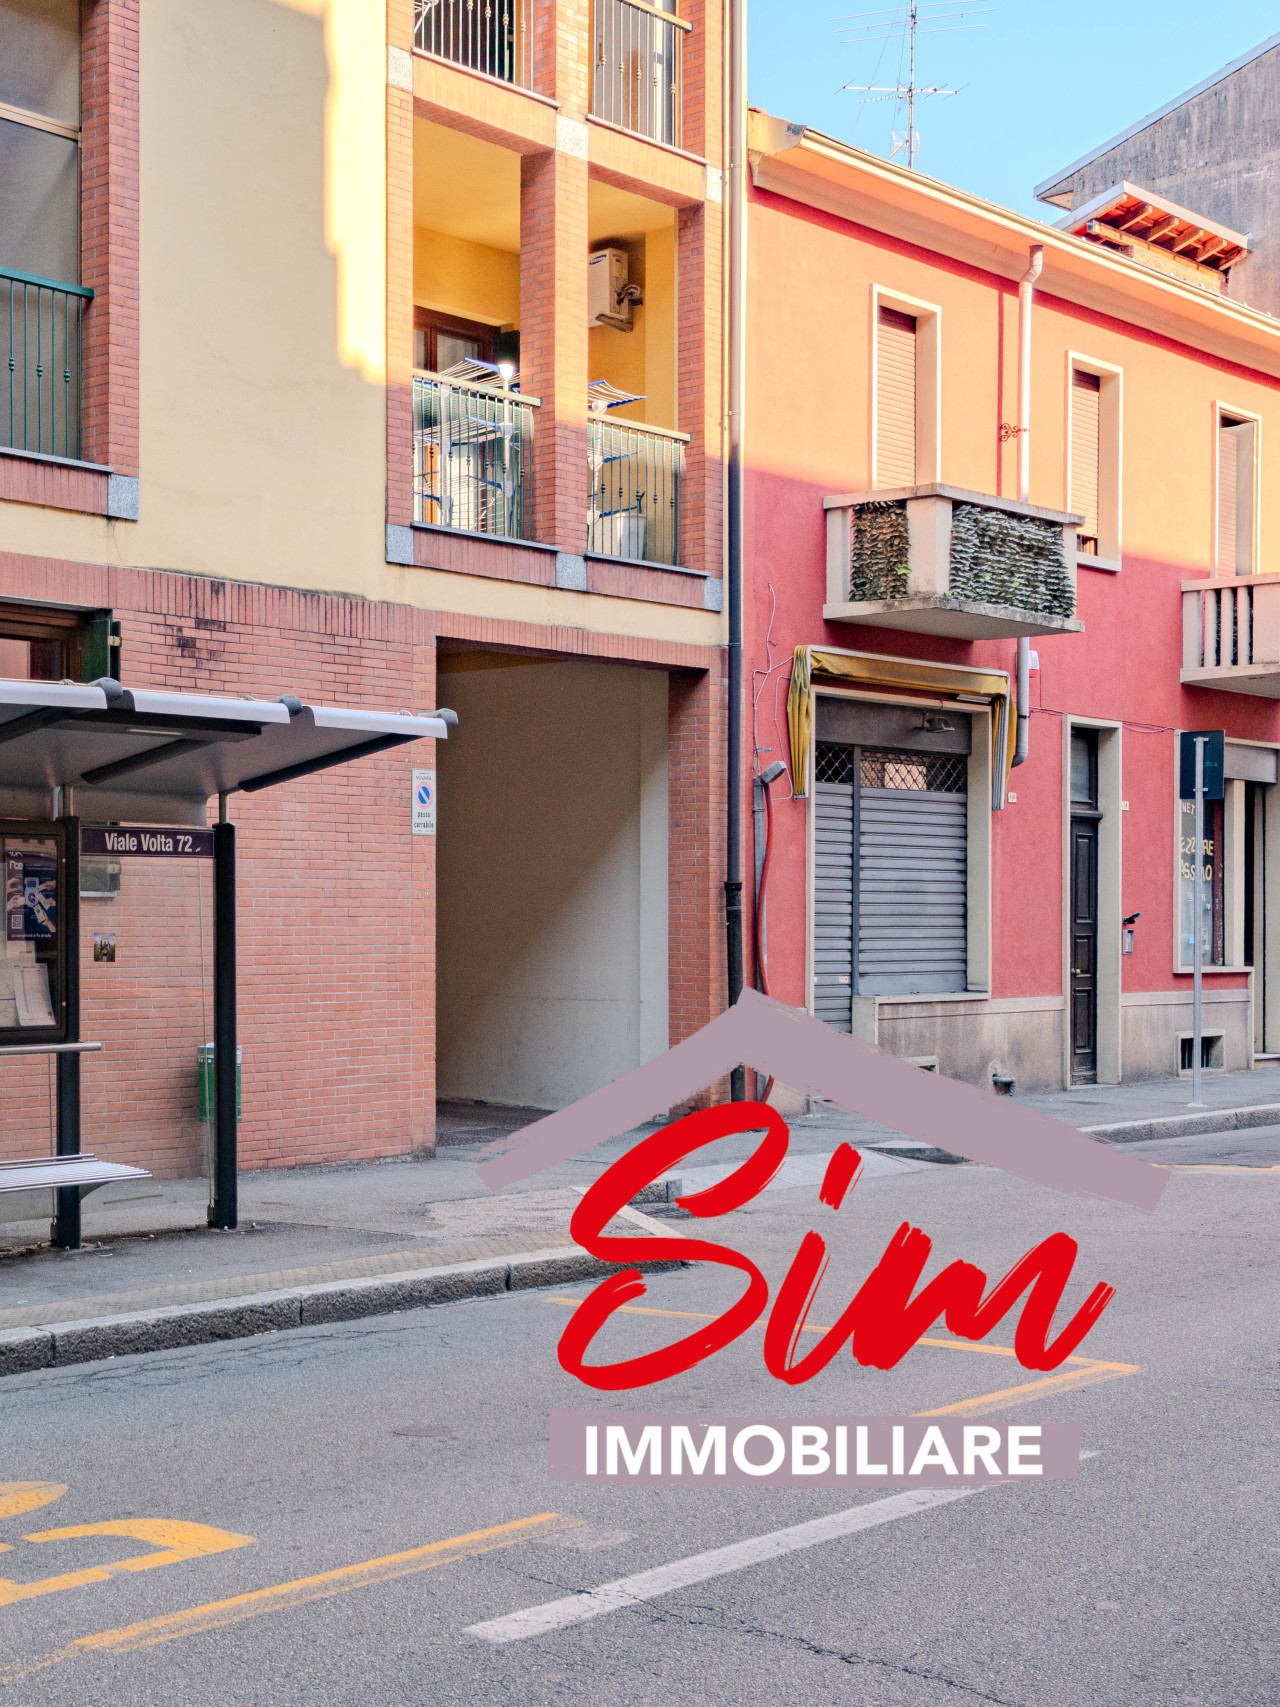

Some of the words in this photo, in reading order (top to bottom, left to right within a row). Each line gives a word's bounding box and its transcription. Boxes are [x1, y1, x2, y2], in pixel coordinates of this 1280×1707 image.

[417, 811, 431, 820] passo
[413, 820, 434, 829] carrabile
[104, 832, 138, 851] Viale
[140, 833, 174, 852] Volta
[176, 835, 193, 852] 72
